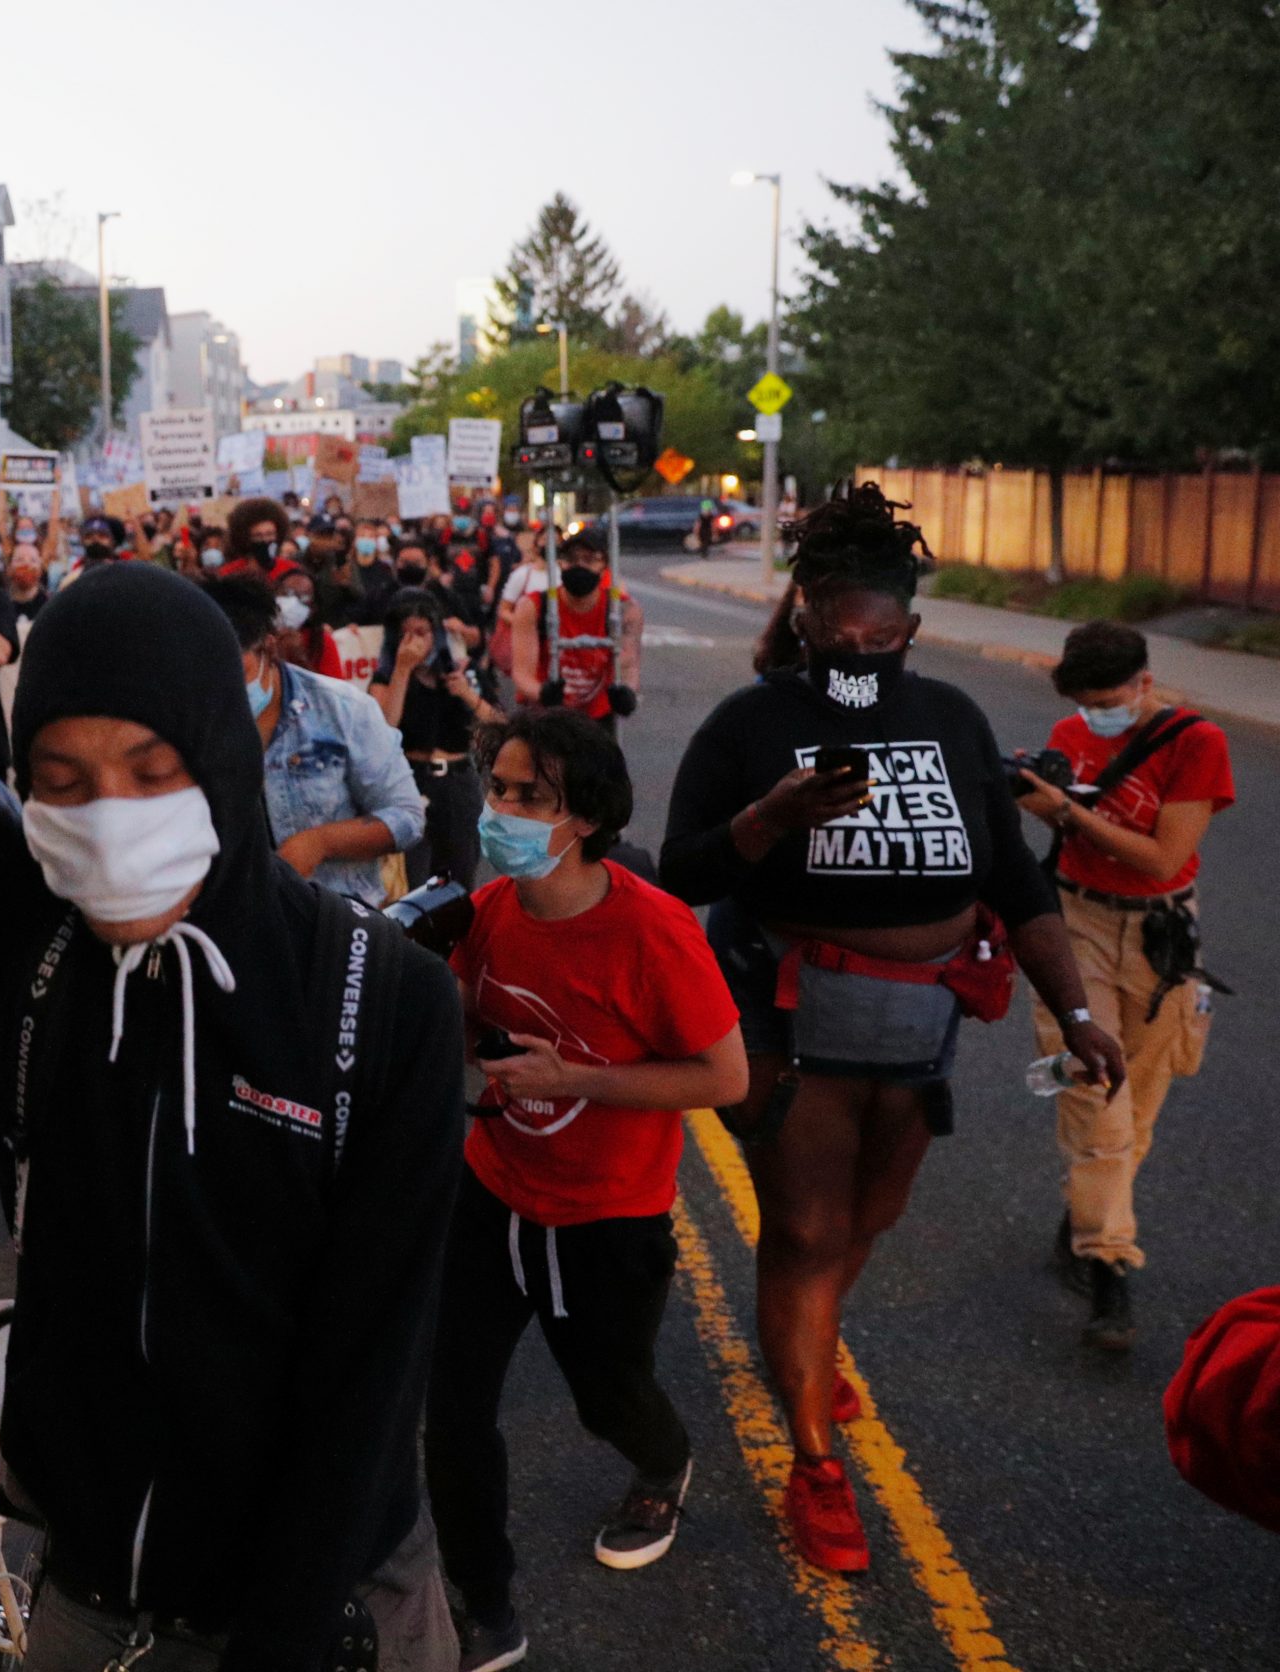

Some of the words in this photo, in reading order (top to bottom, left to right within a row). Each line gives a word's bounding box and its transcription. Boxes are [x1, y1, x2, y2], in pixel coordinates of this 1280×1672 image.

[829, 668, 878, 687] BLACK
[826, 688, 879, 709] MATTER
[813, 829, 969, 867] MATTER
[338, 927, 369, 1047] CONVERSE
[235, 1083, 323, 1128] COASTER
